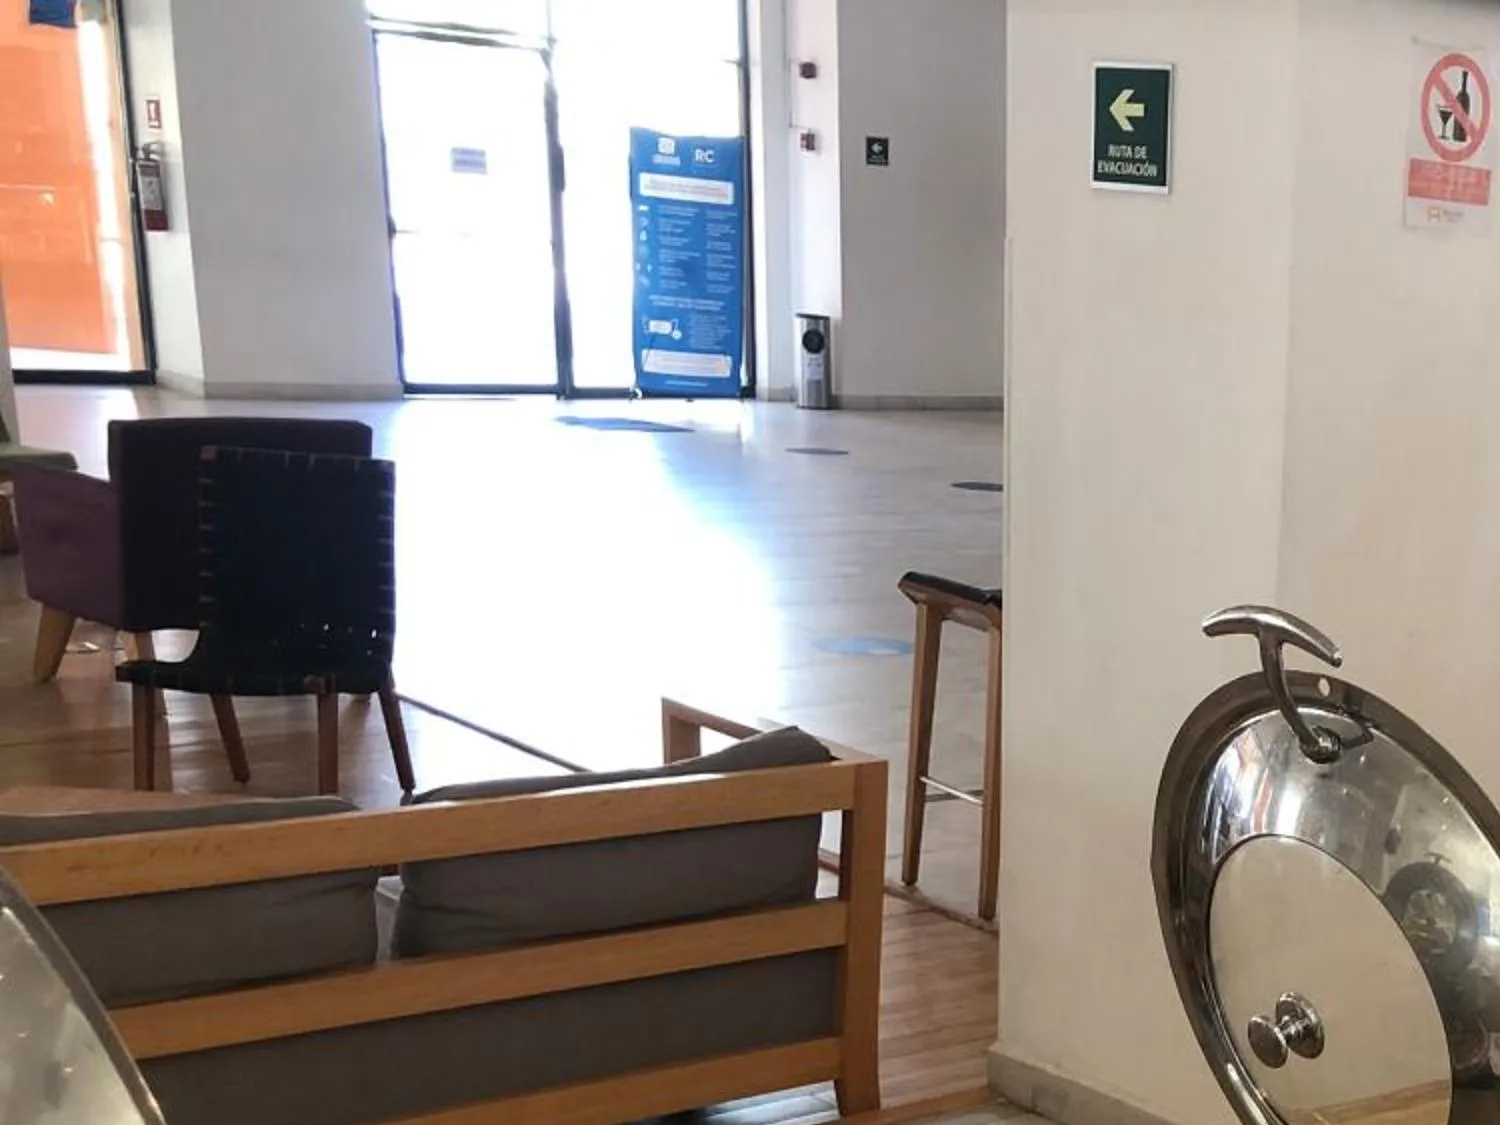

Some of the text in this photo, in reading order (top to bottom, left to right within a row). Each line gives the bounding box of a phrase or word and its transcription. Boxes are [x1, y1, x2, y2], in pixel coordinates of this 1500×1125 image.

[1107, 143, 1147, 159] RUTA DE
[1097, 161, 1158, 177] EVACUACIÓN
